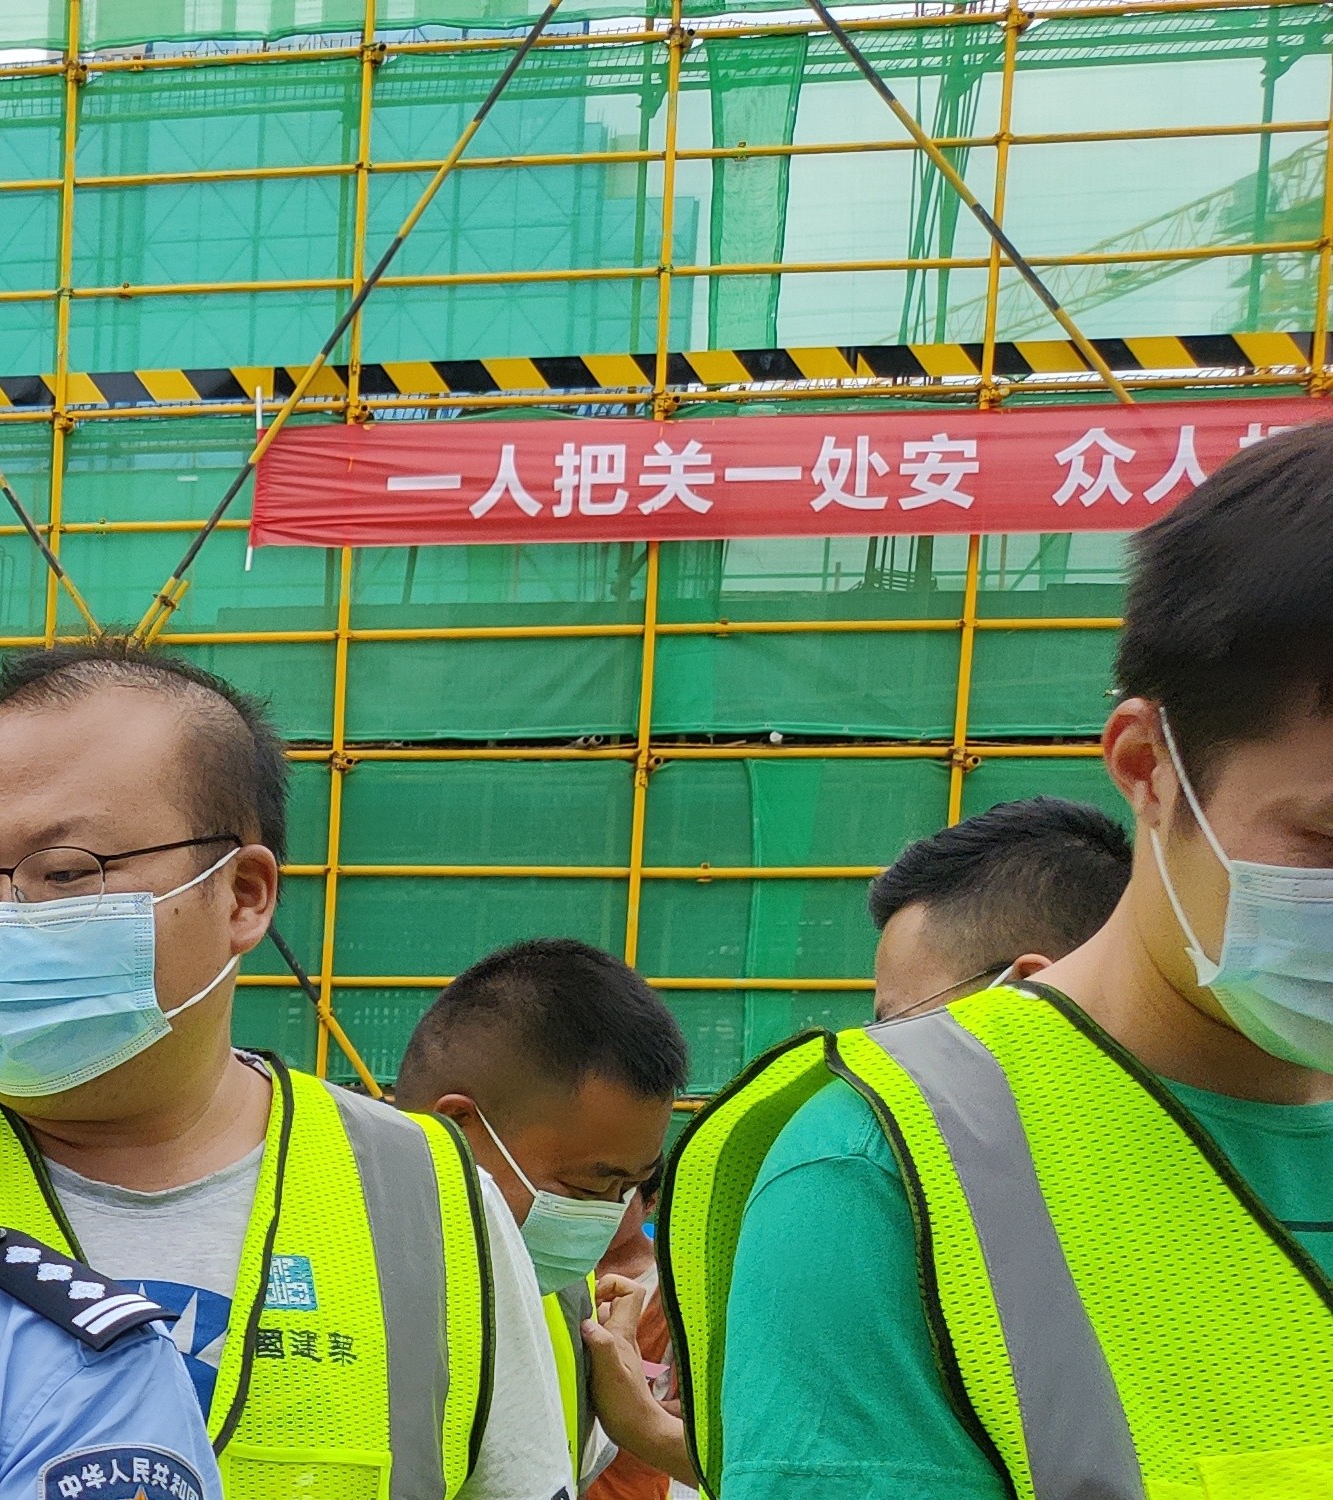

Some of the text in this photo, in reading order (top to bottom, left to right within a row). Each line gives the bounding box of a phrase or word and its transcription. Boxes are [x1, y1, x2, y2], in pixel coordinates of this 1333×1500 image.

[387, 423, 1309, 520] 一人把关一处安 众人
